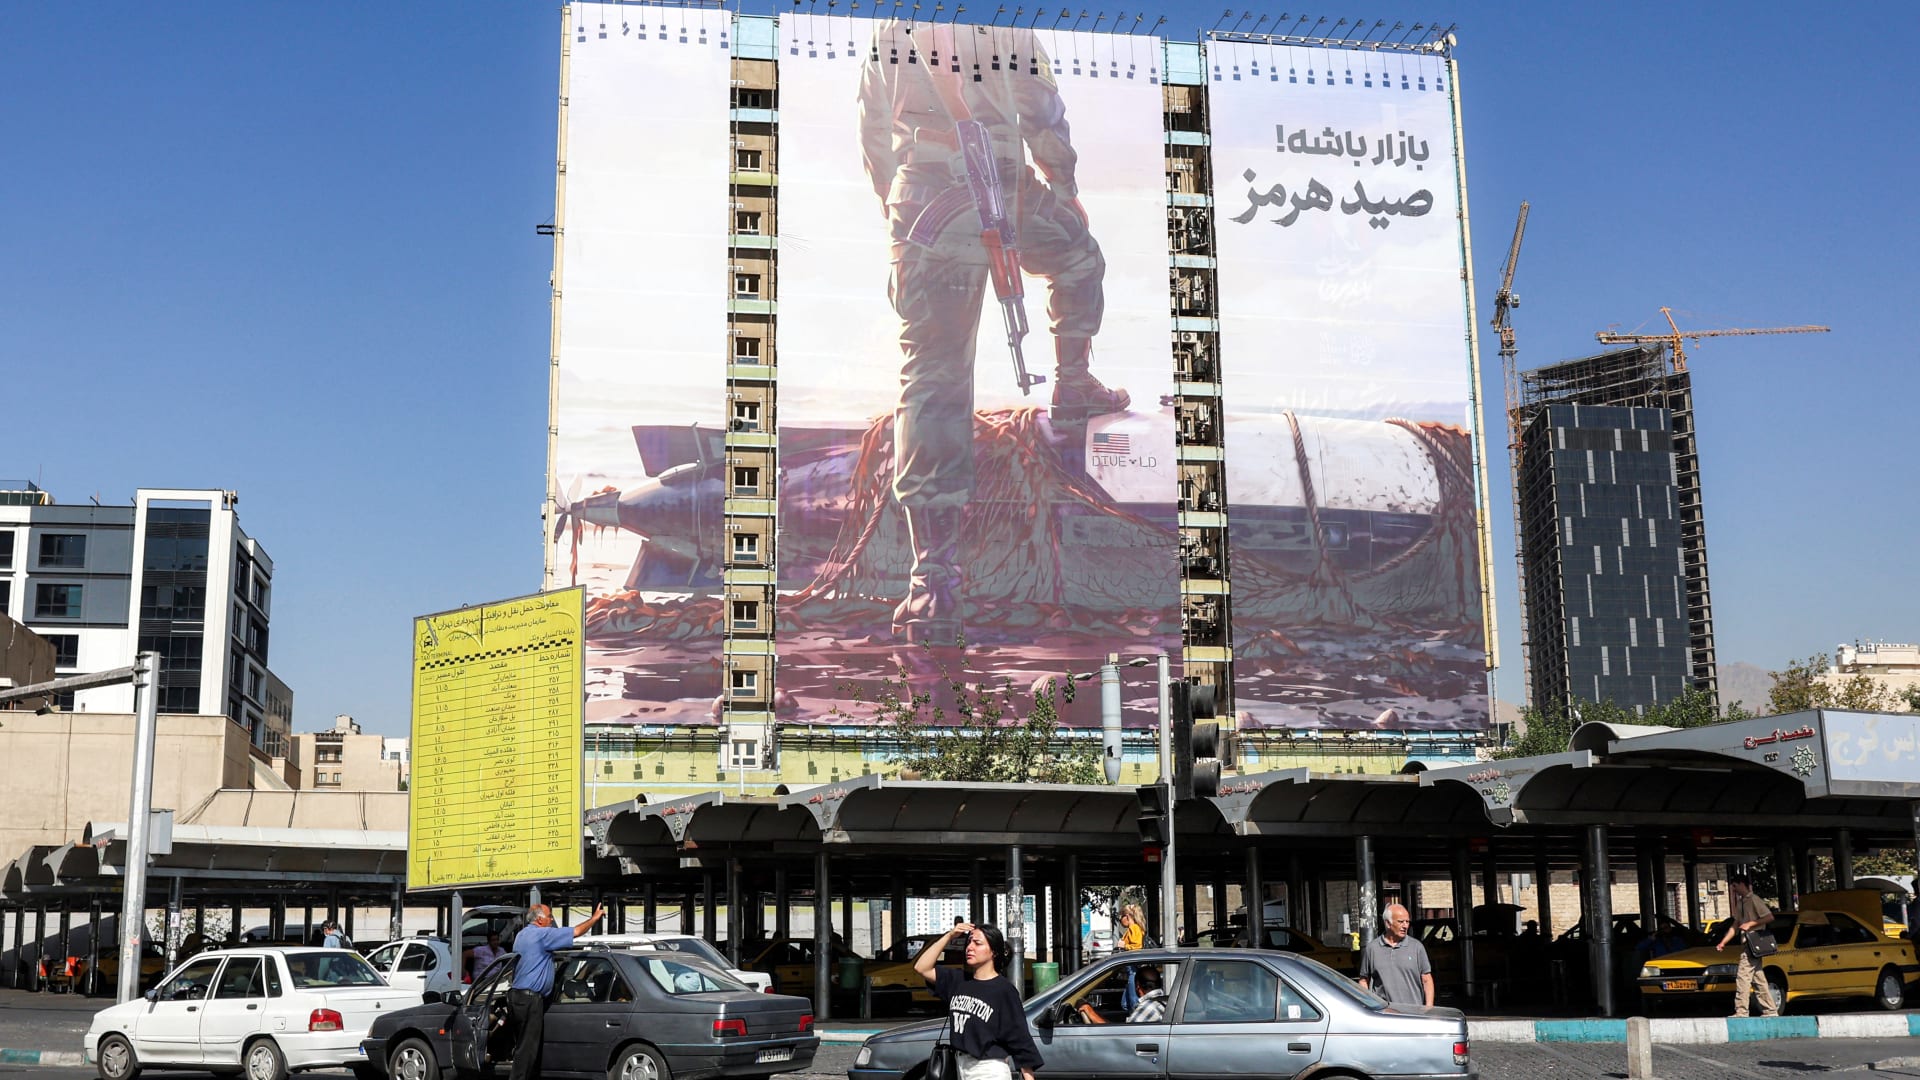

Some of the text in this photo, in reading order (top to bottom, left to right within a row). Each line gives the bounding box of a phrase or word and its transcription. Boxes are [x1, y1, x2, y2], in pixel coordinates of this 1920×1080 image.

[1275, 124, 1430, 170] بازار باشه!
[1229, 167, 1434, 230] صید هرمز
[437, 600, 560, 631] معاونت حمل نقل و ترافیک شهرداری تهران
[489, 661, 508, 670] مقصد
[539, 650, 570, 662] شماره خط
[435, 672, 450, 682] مسیر
[451, 668, 464, 679] طول
[1744, 724, 1816, 750] مقصد کرج
[953, 1011, 971, 1034] W
